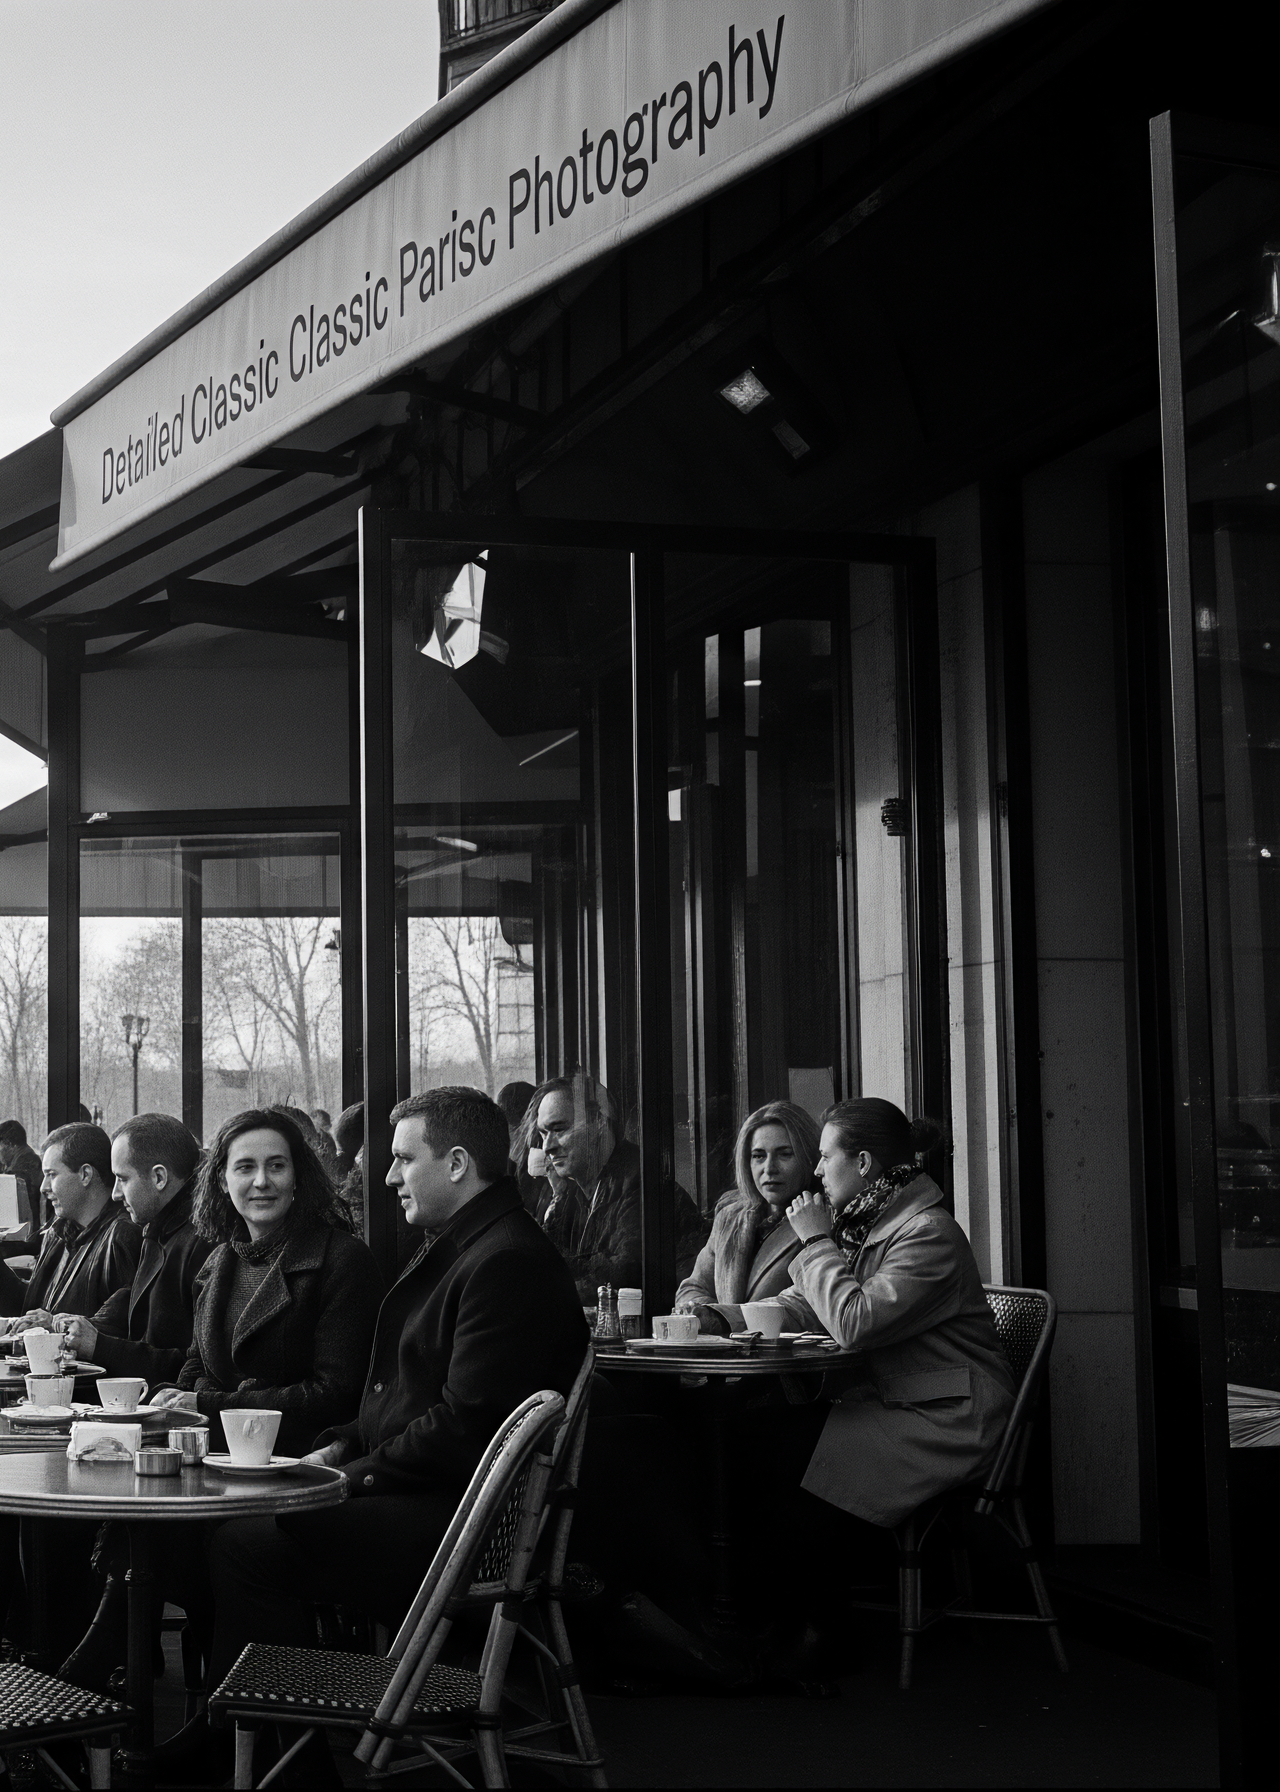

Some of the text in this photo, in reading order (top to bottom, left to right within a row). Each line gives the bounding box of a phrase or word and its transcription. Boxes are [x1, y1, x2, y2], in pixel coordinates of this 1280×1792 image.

[190, 338, 279, 445] Classic
[289, 270, 389, 383] Classic
[399, 206, 496, 318] Parisc
[508, 14, 786, 250] Photography
